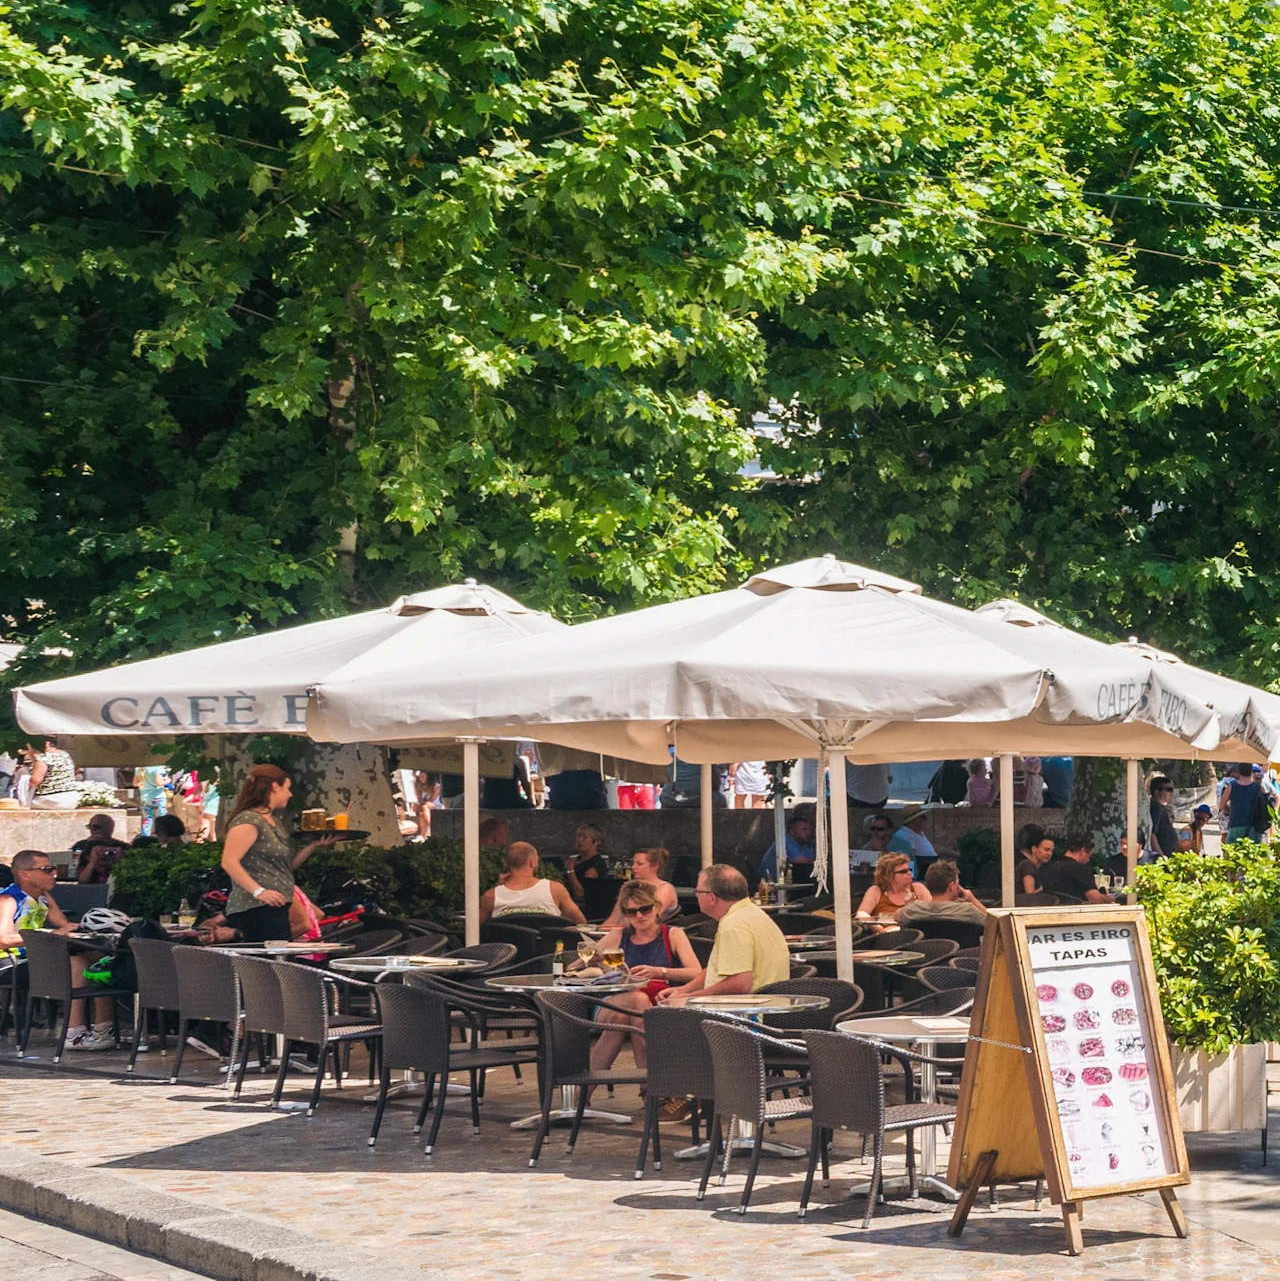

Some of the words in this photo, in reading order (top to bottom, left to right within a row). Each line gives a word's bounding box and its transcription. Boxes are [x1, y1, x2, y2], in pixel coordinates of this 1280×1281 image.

[101, 691, 259, 728] CAFÈ
[1061, 931, 1085, 942] ES
[1090, 928, 1131, 941] FIRO
[1049, 947, 1108, 961] TAPAS
